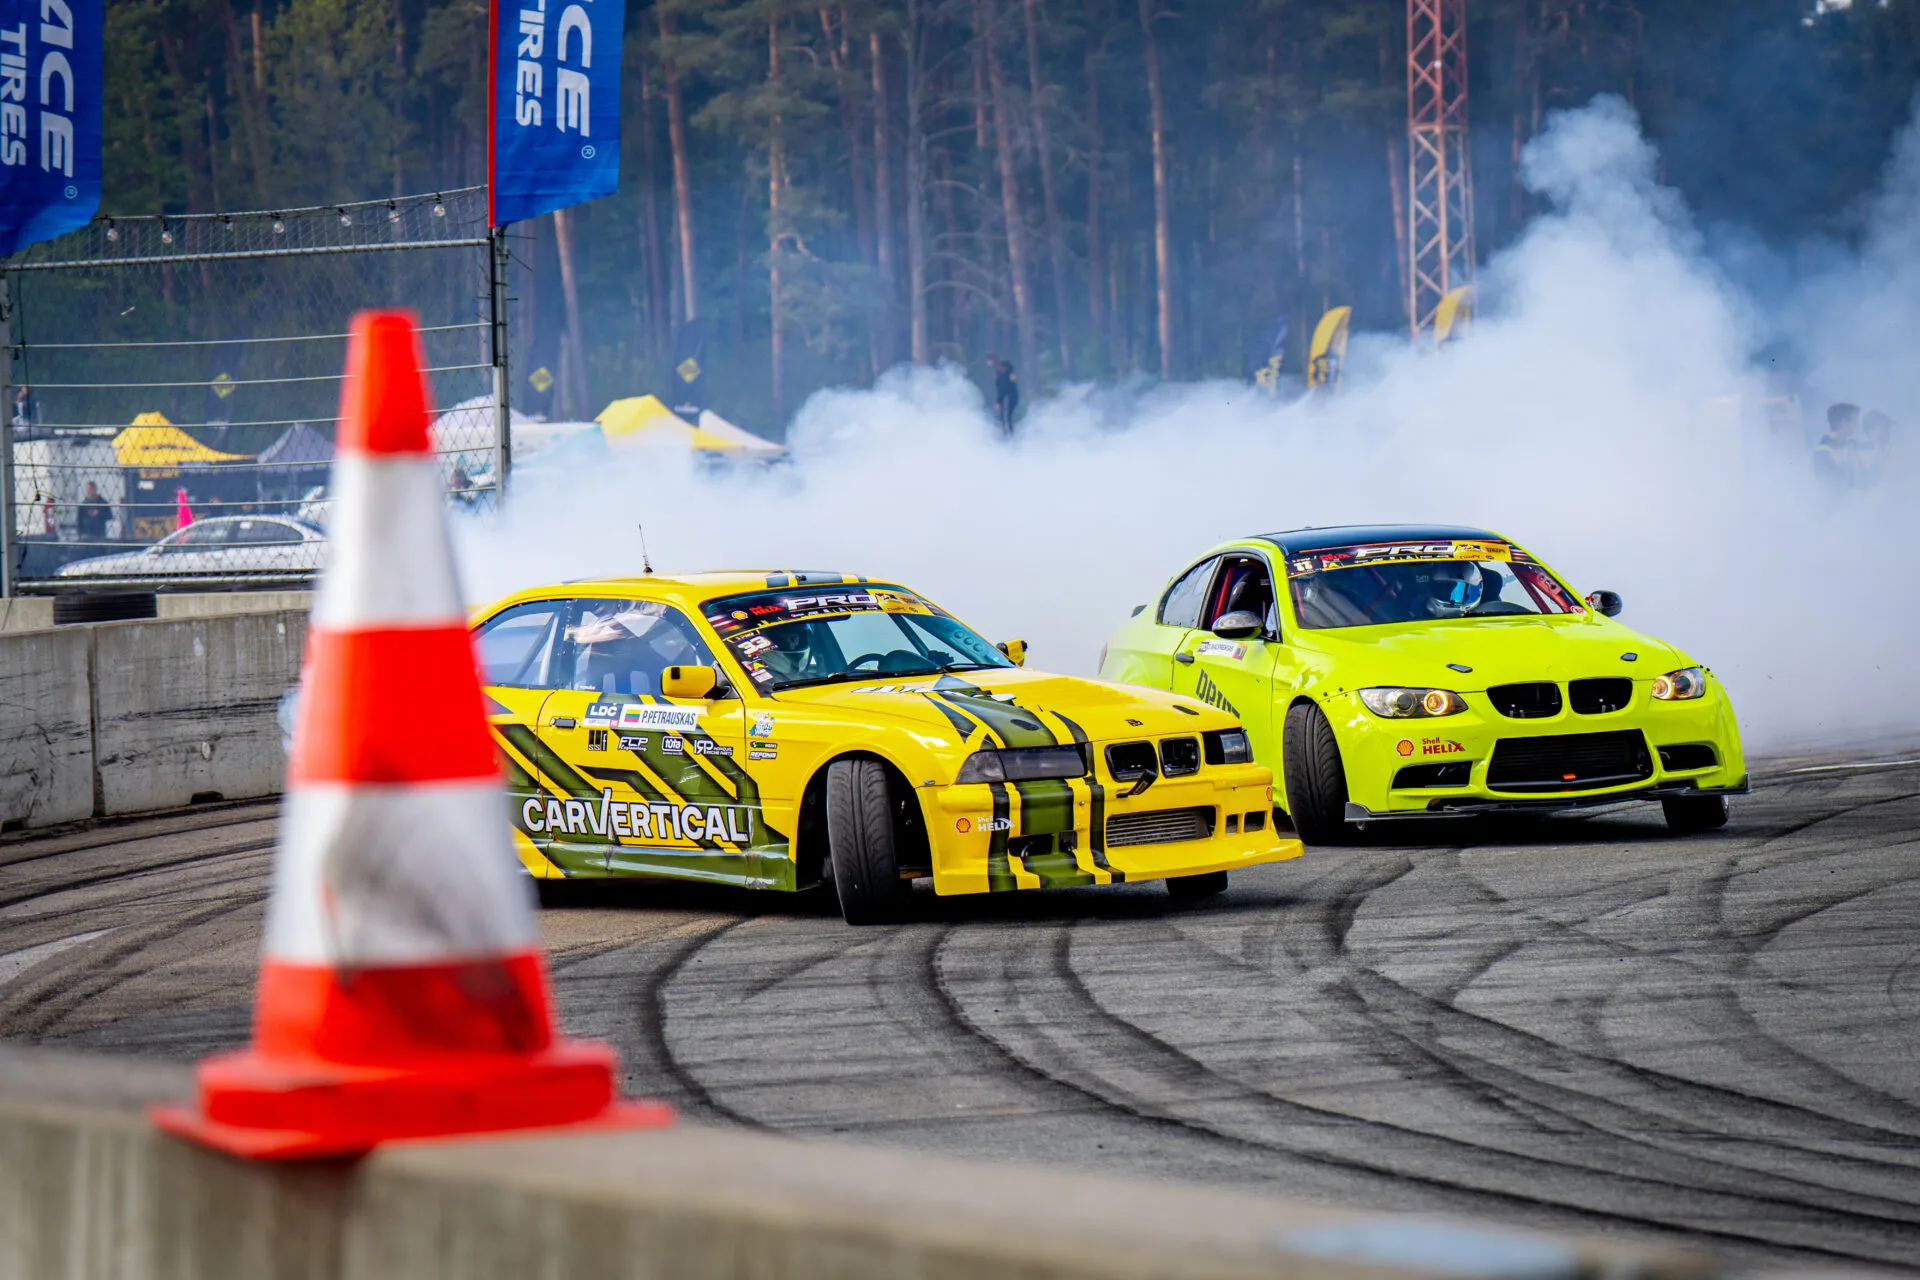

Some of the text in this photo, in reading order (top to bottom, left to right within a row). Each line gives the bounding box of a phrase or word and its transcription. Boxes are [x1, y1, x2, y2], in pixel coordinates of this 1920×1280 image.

[556, 0, 593, 137] CE
[0, 22, 26, 166] TIRES
[40, 0, 73, 178] ACE
[1356, 545, 1458, 558] PRO
[784, 594, 879, 610] PRO
[737, 635, 771, 655] 33
[641, 710, 696, 726] P.PETRAUSKAS
[1422, 742, 1464, 755] HELIX
[521, 787, 749, 842] CARVERTICAL
[978, 819, 1015, 832] HELIX
